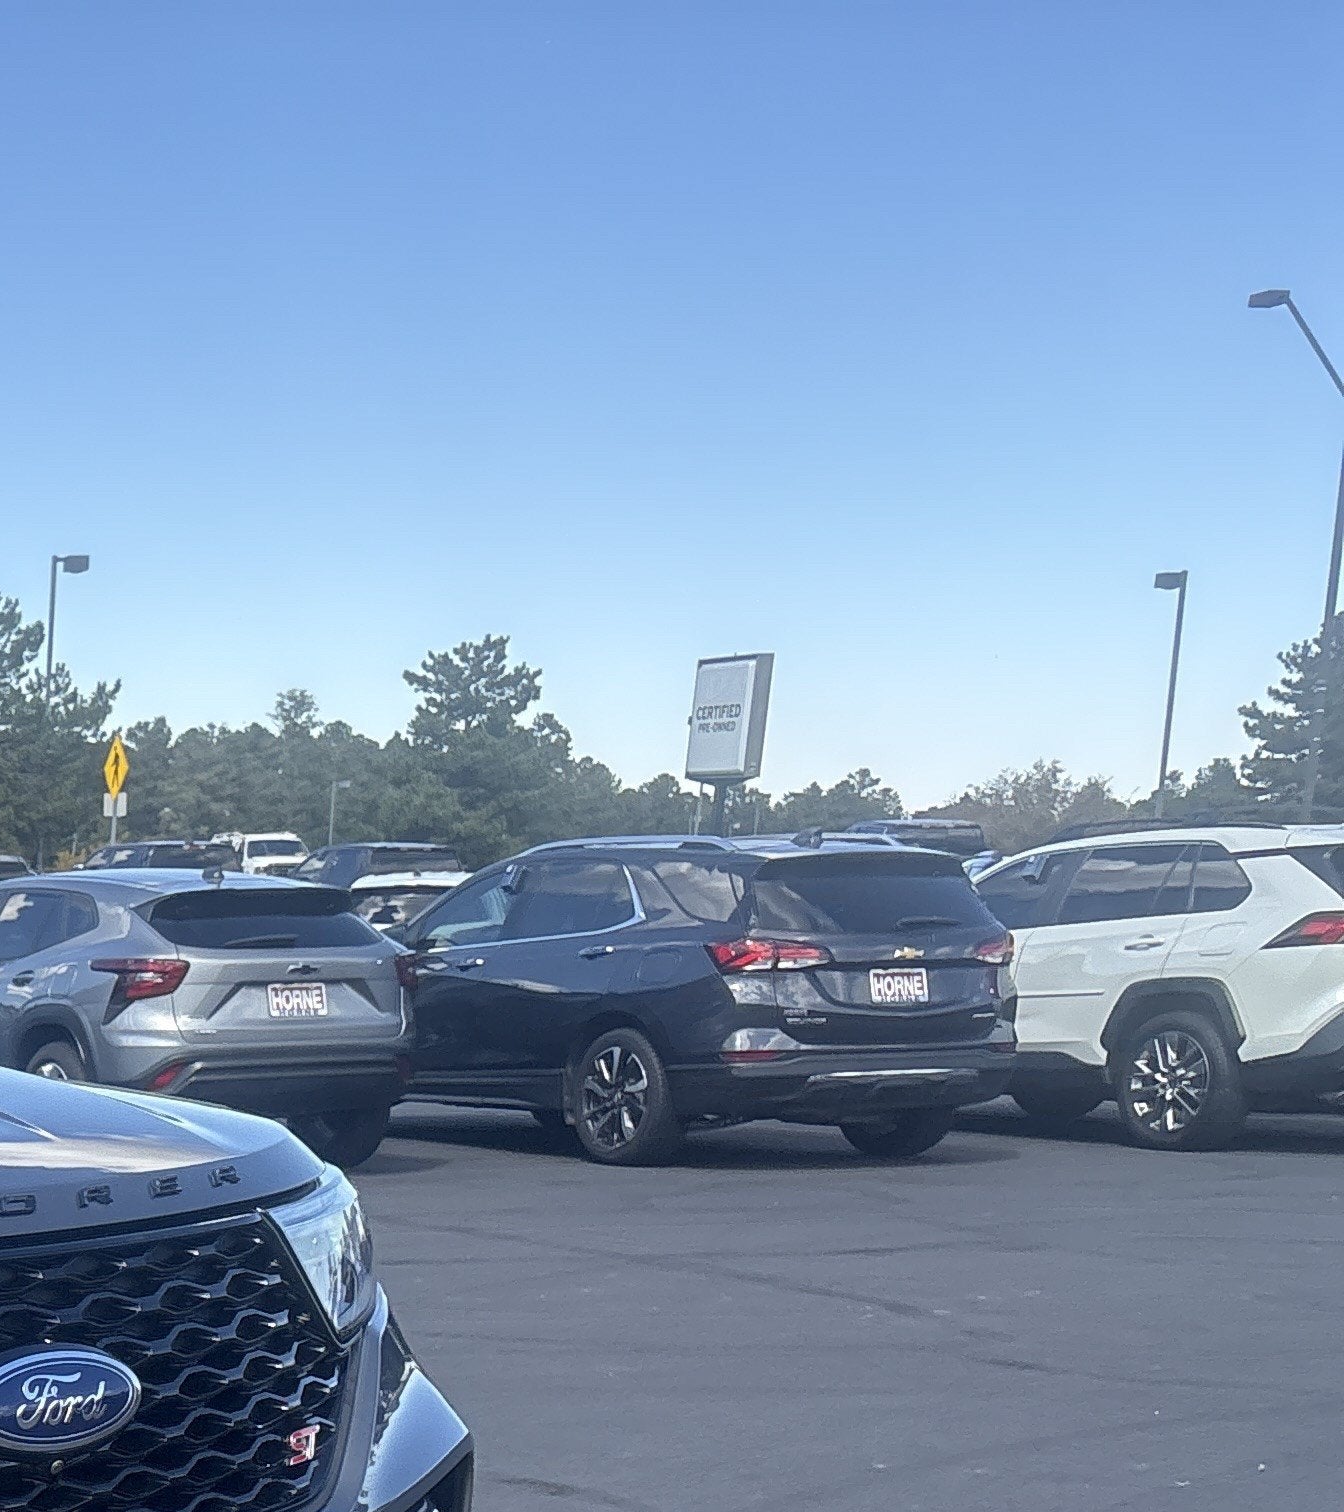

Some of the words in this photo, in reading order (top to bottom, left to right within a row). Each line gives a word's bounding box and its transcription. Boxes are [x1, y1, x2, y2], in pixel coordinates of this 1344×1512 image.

[696, 703, 742, 720] CERTIFIED
[873, 975, 924, 997] HORNE
[272, 989, 323, 1011] HORNE
[16, 1371, 109, 1430] Ford
[286, 1423, 321, 1467] ST
